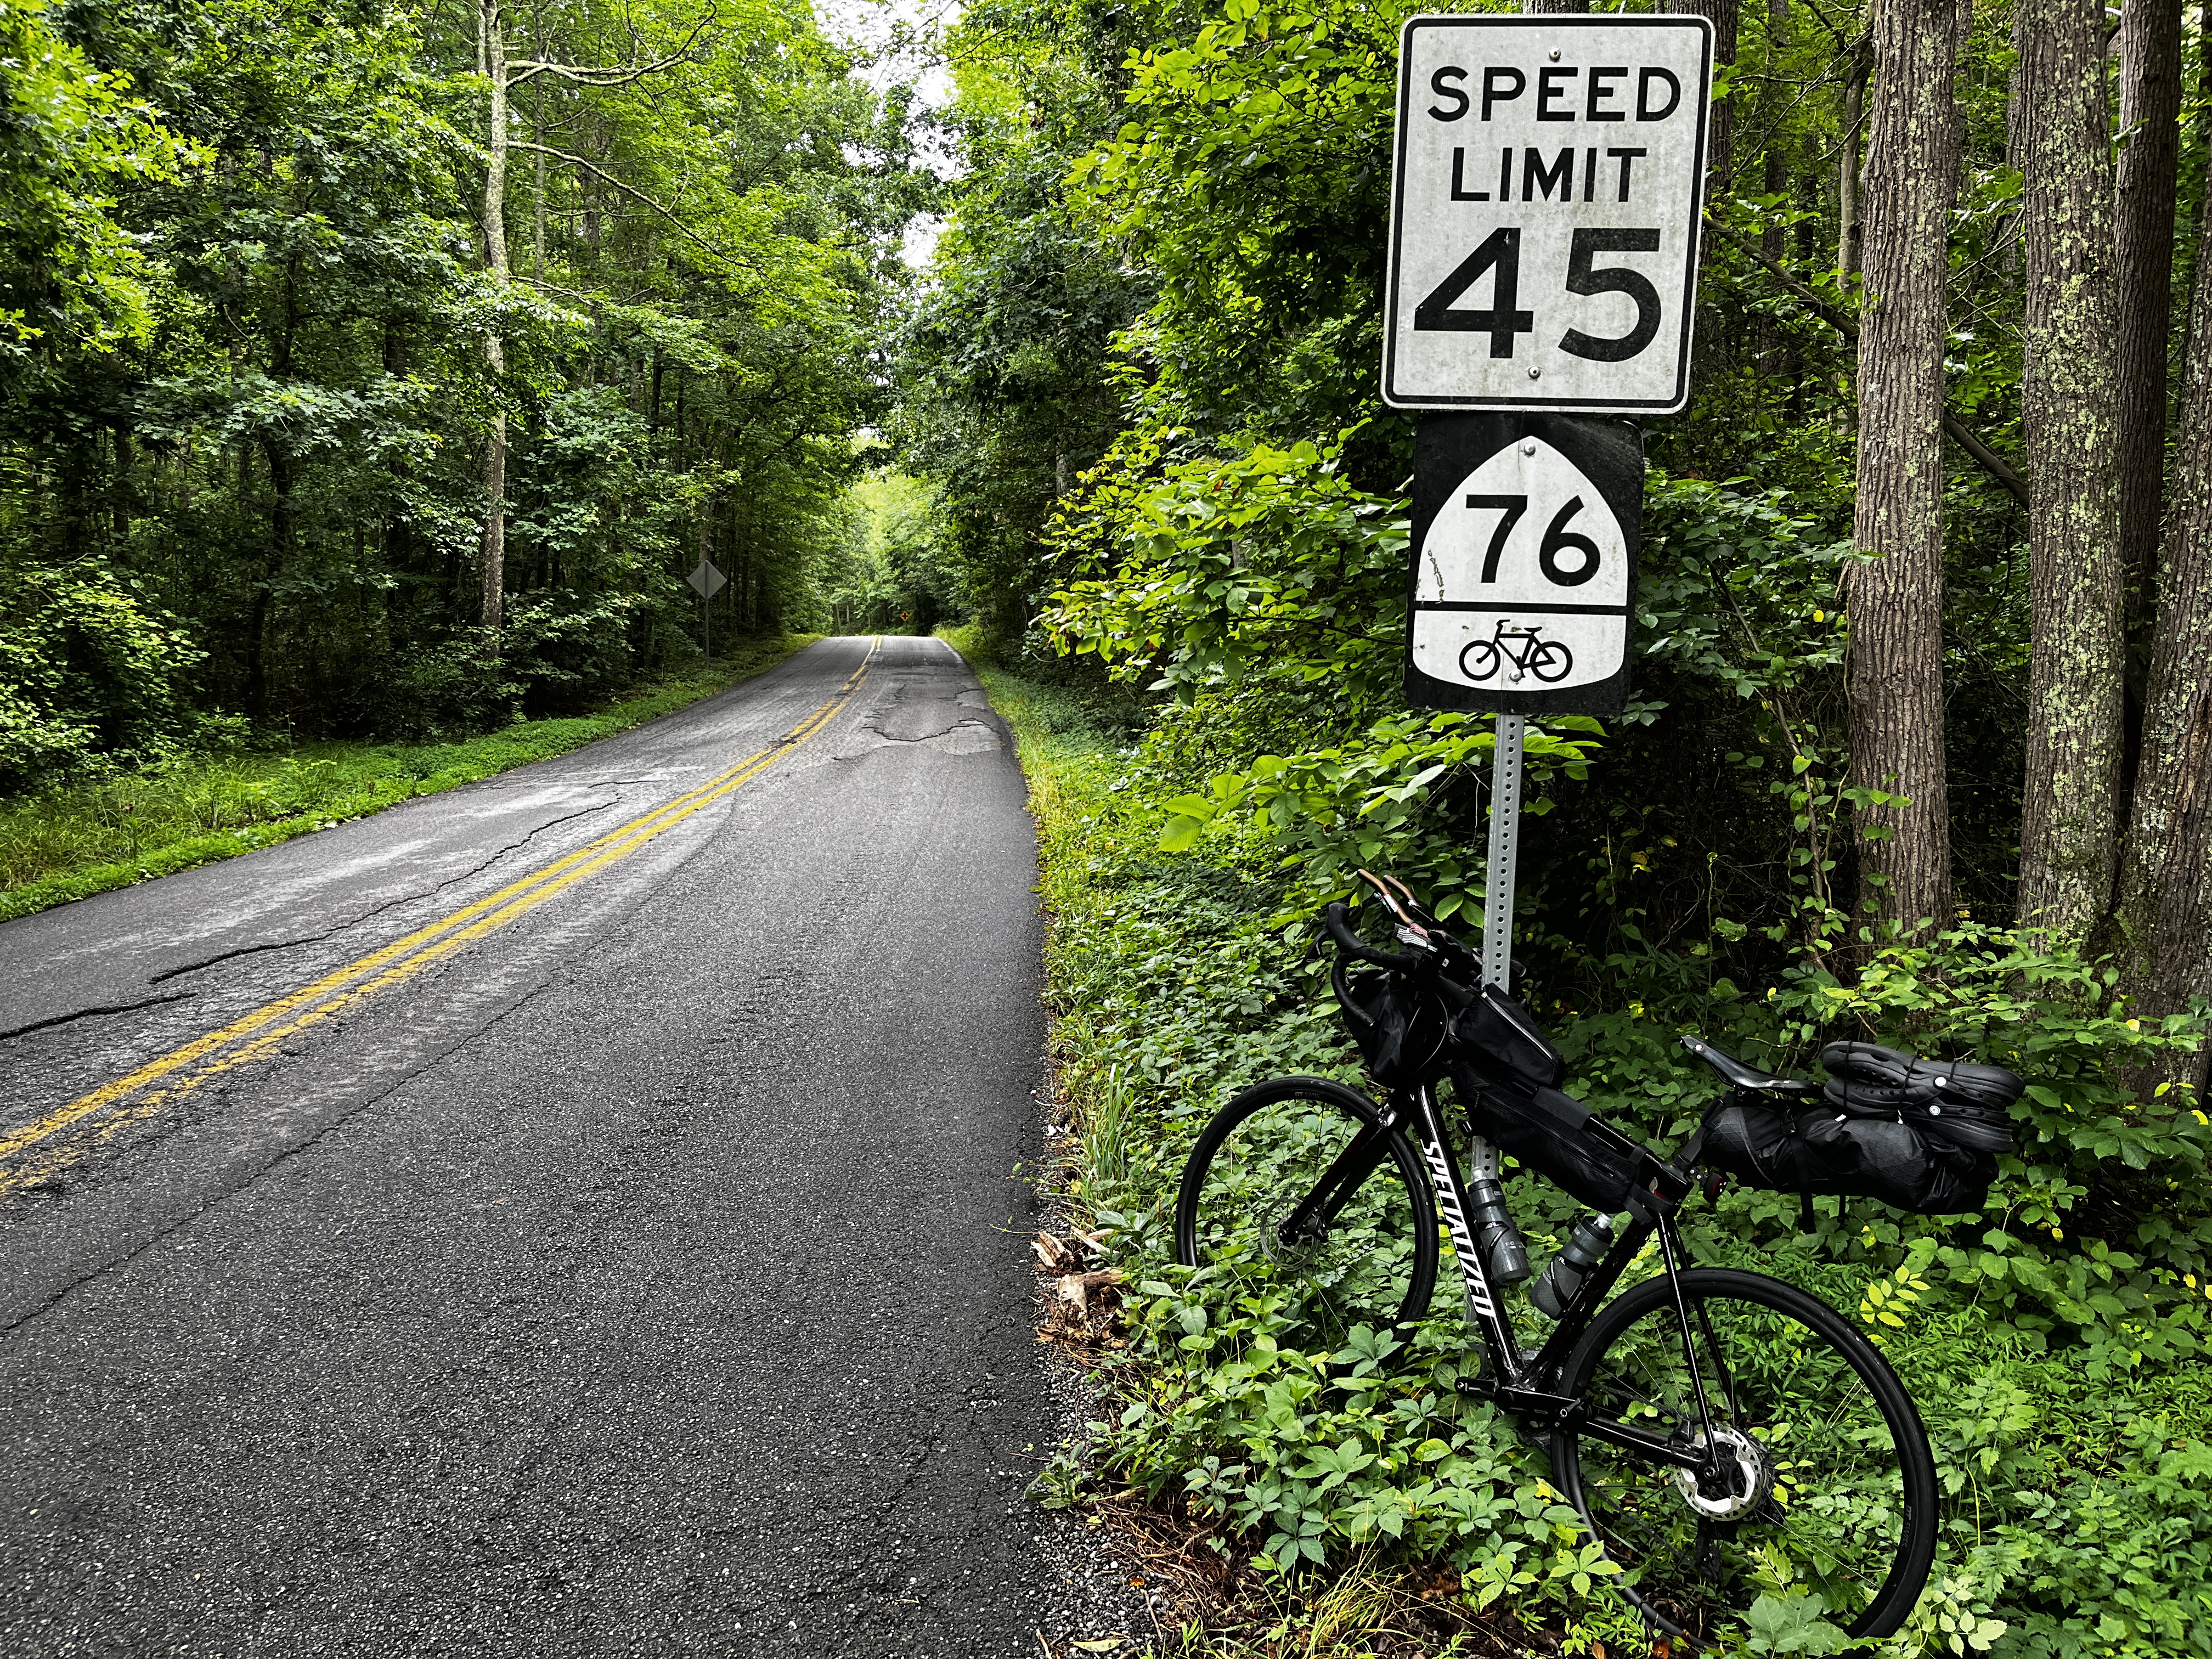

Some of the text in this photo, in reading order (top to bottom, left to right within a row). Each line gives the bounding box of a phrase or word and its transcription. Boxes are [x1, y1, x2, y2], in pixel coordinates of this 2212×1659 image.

[1427, 66, 1681, 122] SPEED
[1451, 147, 1647, 202] LIMIT
[1413, 227, 1662, 363] 45
[1465, 494, 1601, 587] 76
[1420, 1138, 1497, 1318] SPECIALIZED
